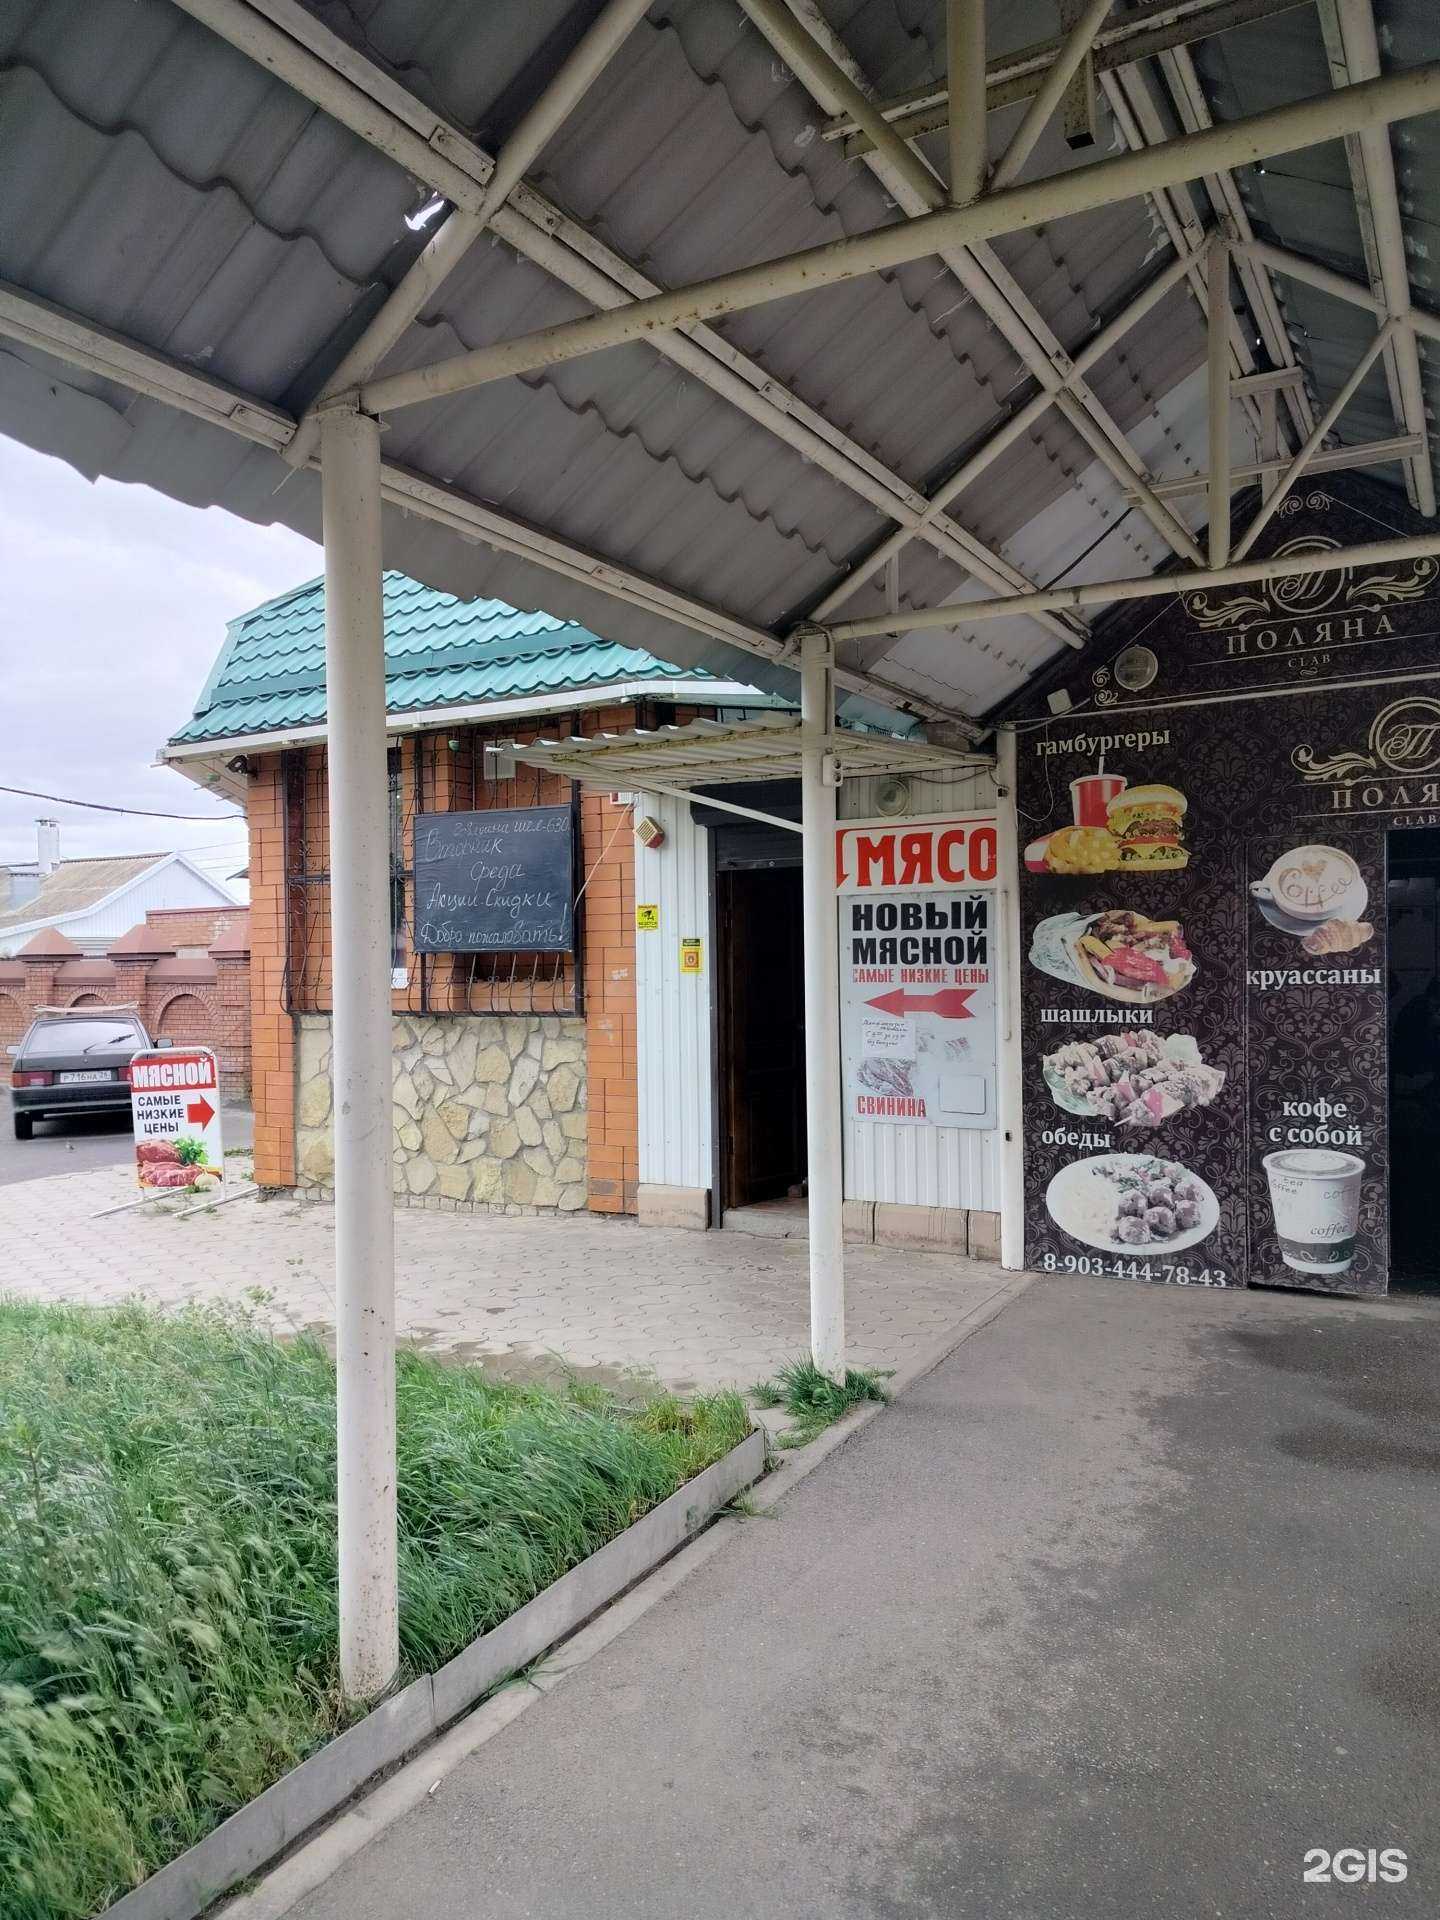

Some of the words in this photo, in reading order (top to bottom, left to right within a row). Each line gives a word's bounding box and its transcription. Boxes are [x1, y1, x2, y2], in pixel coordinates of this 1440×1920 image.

[1226, 614, 1396, 655] ПОЛЯНА
[1288, 653, 1331, 668] CLAB
[1036, 729, 1170, 756] гамбургеры
[1393, 815, 1437, 826] CLAB
[856, 827, 997, 887] МЯСО
[470, 861, 526, 891] Среда
[851, 895, 988, 931] НОВЫЙ
[420, 919, 463, 946] Добро
[851, 930, 988, 965] МЯСНОЙ
[852, 968, 895, 983] САМЫЕ
[900, 968, 949, 983] НИЗКИЕ
[954, 968, 989, 985] ЦЕНЫ
[1246, 968, 1382, 990] круассаны
[1040, 1008, 1154, 1024] шашлыки
[132, 1057, 213, 1088] МЯСНОЙ
[137, 1095, 182, 1107] САМЫЕ
[857, 1095, 927, 1117] СВИНИНА
[1283, 1097, 1348, 1123] кофе
[136, 1108, 185, 1120] НИЗКИЕ
[144, 1122, 180, 1135] ЦЕНЫ
[1041, 1126, 1112, 1151] обеды
[1269, 1127, 1282, 1142] с
[1287, 1123, 1363, 1146] собой
[1043, 1253, 1227, 1288] 8-903-444-78-43
